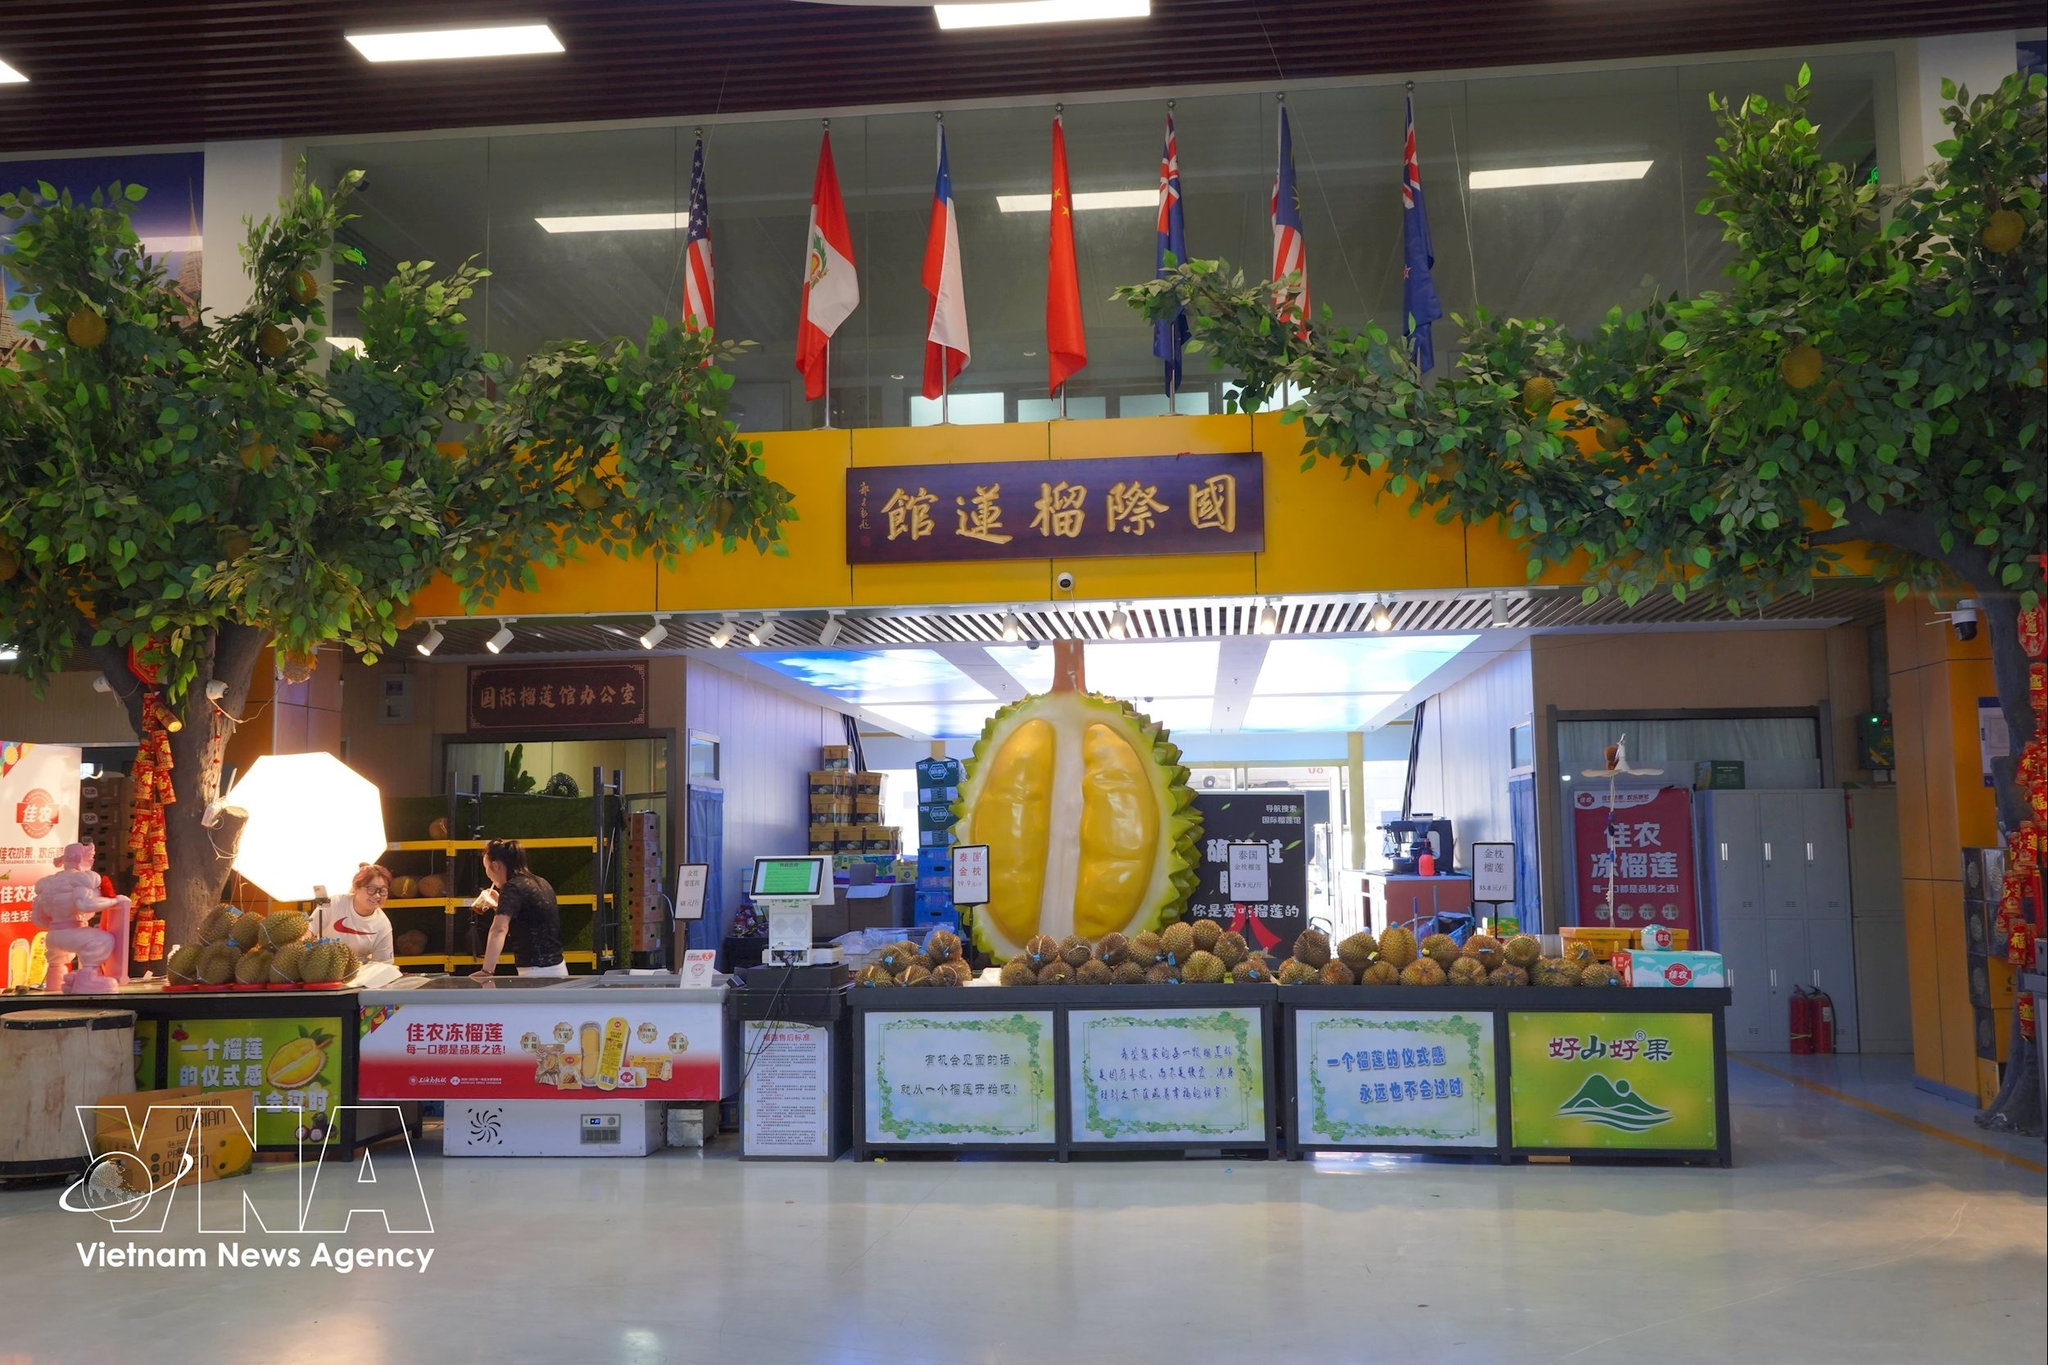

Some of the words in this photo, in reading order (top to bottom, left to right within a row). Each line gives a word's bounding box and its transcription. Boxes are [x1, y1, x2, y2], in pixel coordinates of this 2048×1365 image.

[480, 683, 637, 710] 国际榴莲馆办公室
[23, 804, 53, 823] 佳农
[1603, 821, 1662, 848] 佳农
[1206, 838, 1284, 864] 确过
[1484, 848, 1504, 859] 金枕
[959, 866, 982, 877] 金枕
[1484, 862, 1505, 874] 榴莲
[1590, 851, 1678, 879] 冻榴莲
[406, 1022, 504, 1043] 佳农冻榴莲
[180, 1037, 264, 1061] 一个榴莲
[1327, 1045, 1446, 1071] 一个榴莲的仪式感
[1549, 1034, 1673, 1062] 好山好果
[179, 1065, 263, 1088] 的仪式感
[1359, 1078, 1465, 1103] 永远也不会过时
